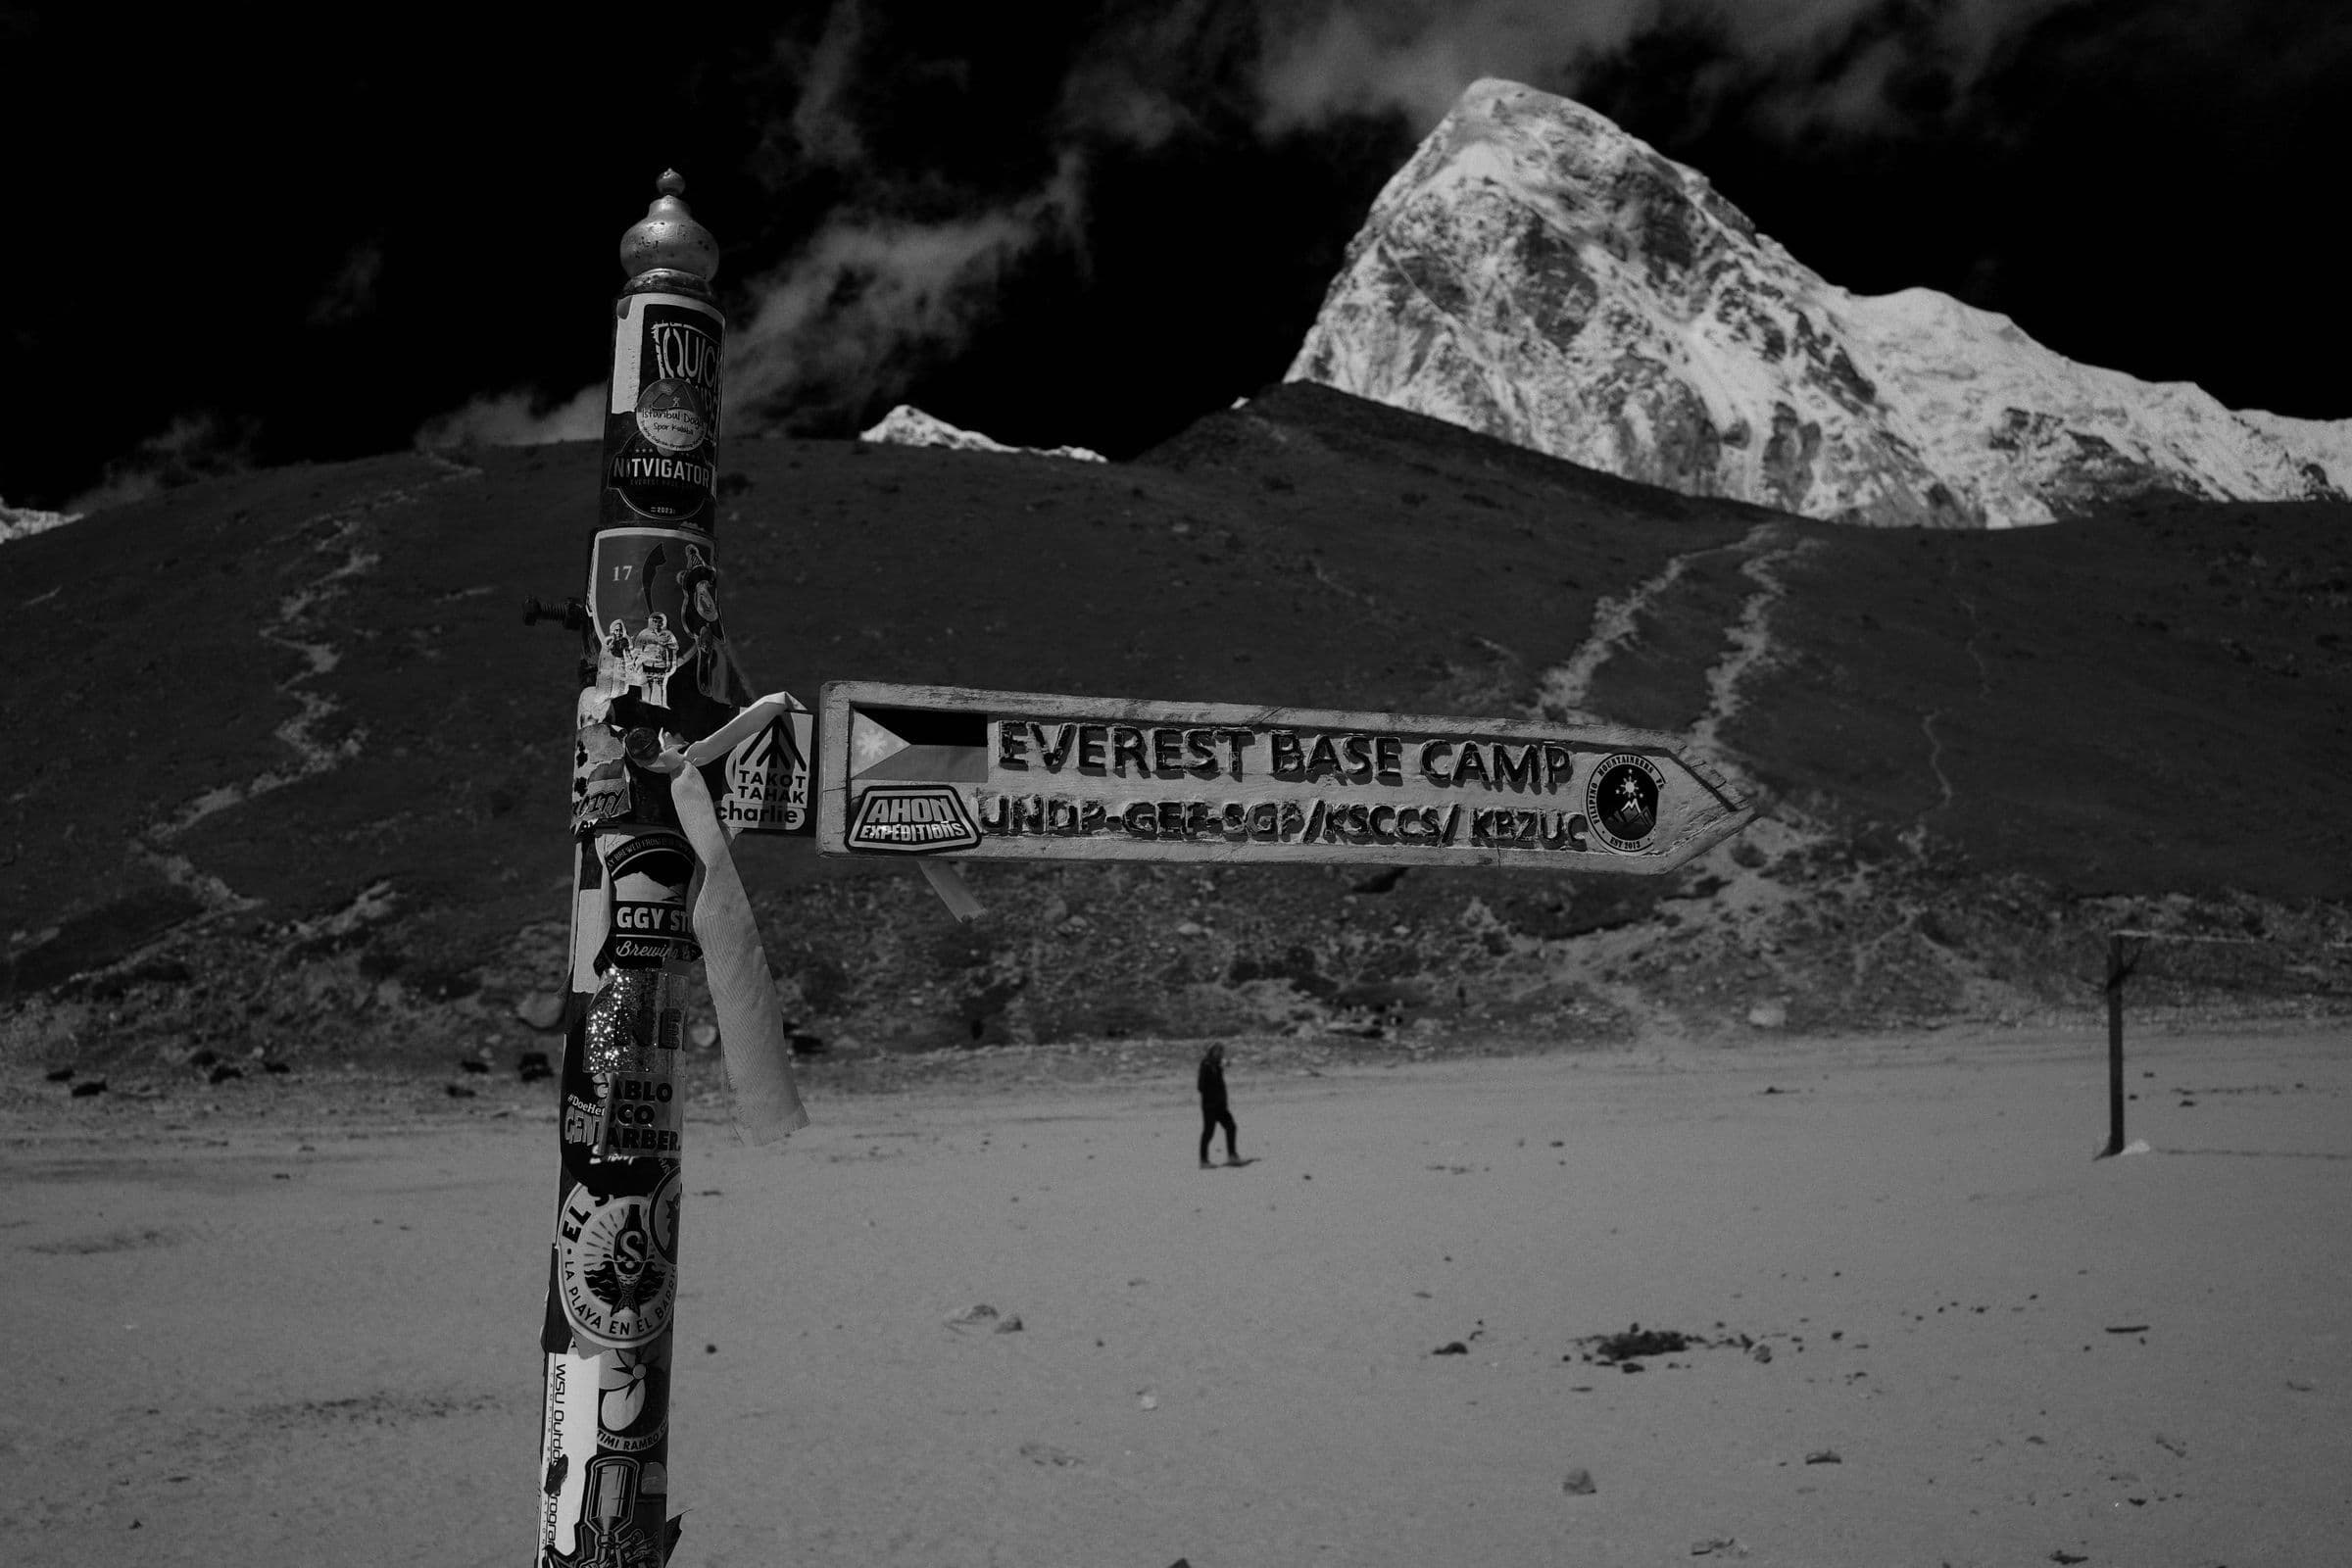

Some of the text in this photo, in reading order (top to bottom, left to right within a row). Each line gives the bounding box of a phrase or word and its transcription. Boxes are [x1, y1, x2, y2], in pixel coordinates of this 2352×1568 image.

[612, 565, 633, 581] 17
[998, 720, 1573, 795] EVEREST BASE CAMP
[738, 769, 807, 789] TAKOT
[738, 786, 805, 804] TAHAK
[1589, 754, 1654, 825] FILIPINO MOUNTAINEERS
[715, 801, 799, 823] charlie
[866, 798, 956, 823] AHON
[859, 822, 964, 842] EXPEDITIONS
[1609, 837, 1641, 850] EST 2013
[564, 1261, 575, 1281] LA
[568, 1286, 603, 1329] PLAYA
[609, 1320, 630, 1336] EN
[637, 1317, 653, 1334] EL
[555, 1363, 566, 1404] WSU
